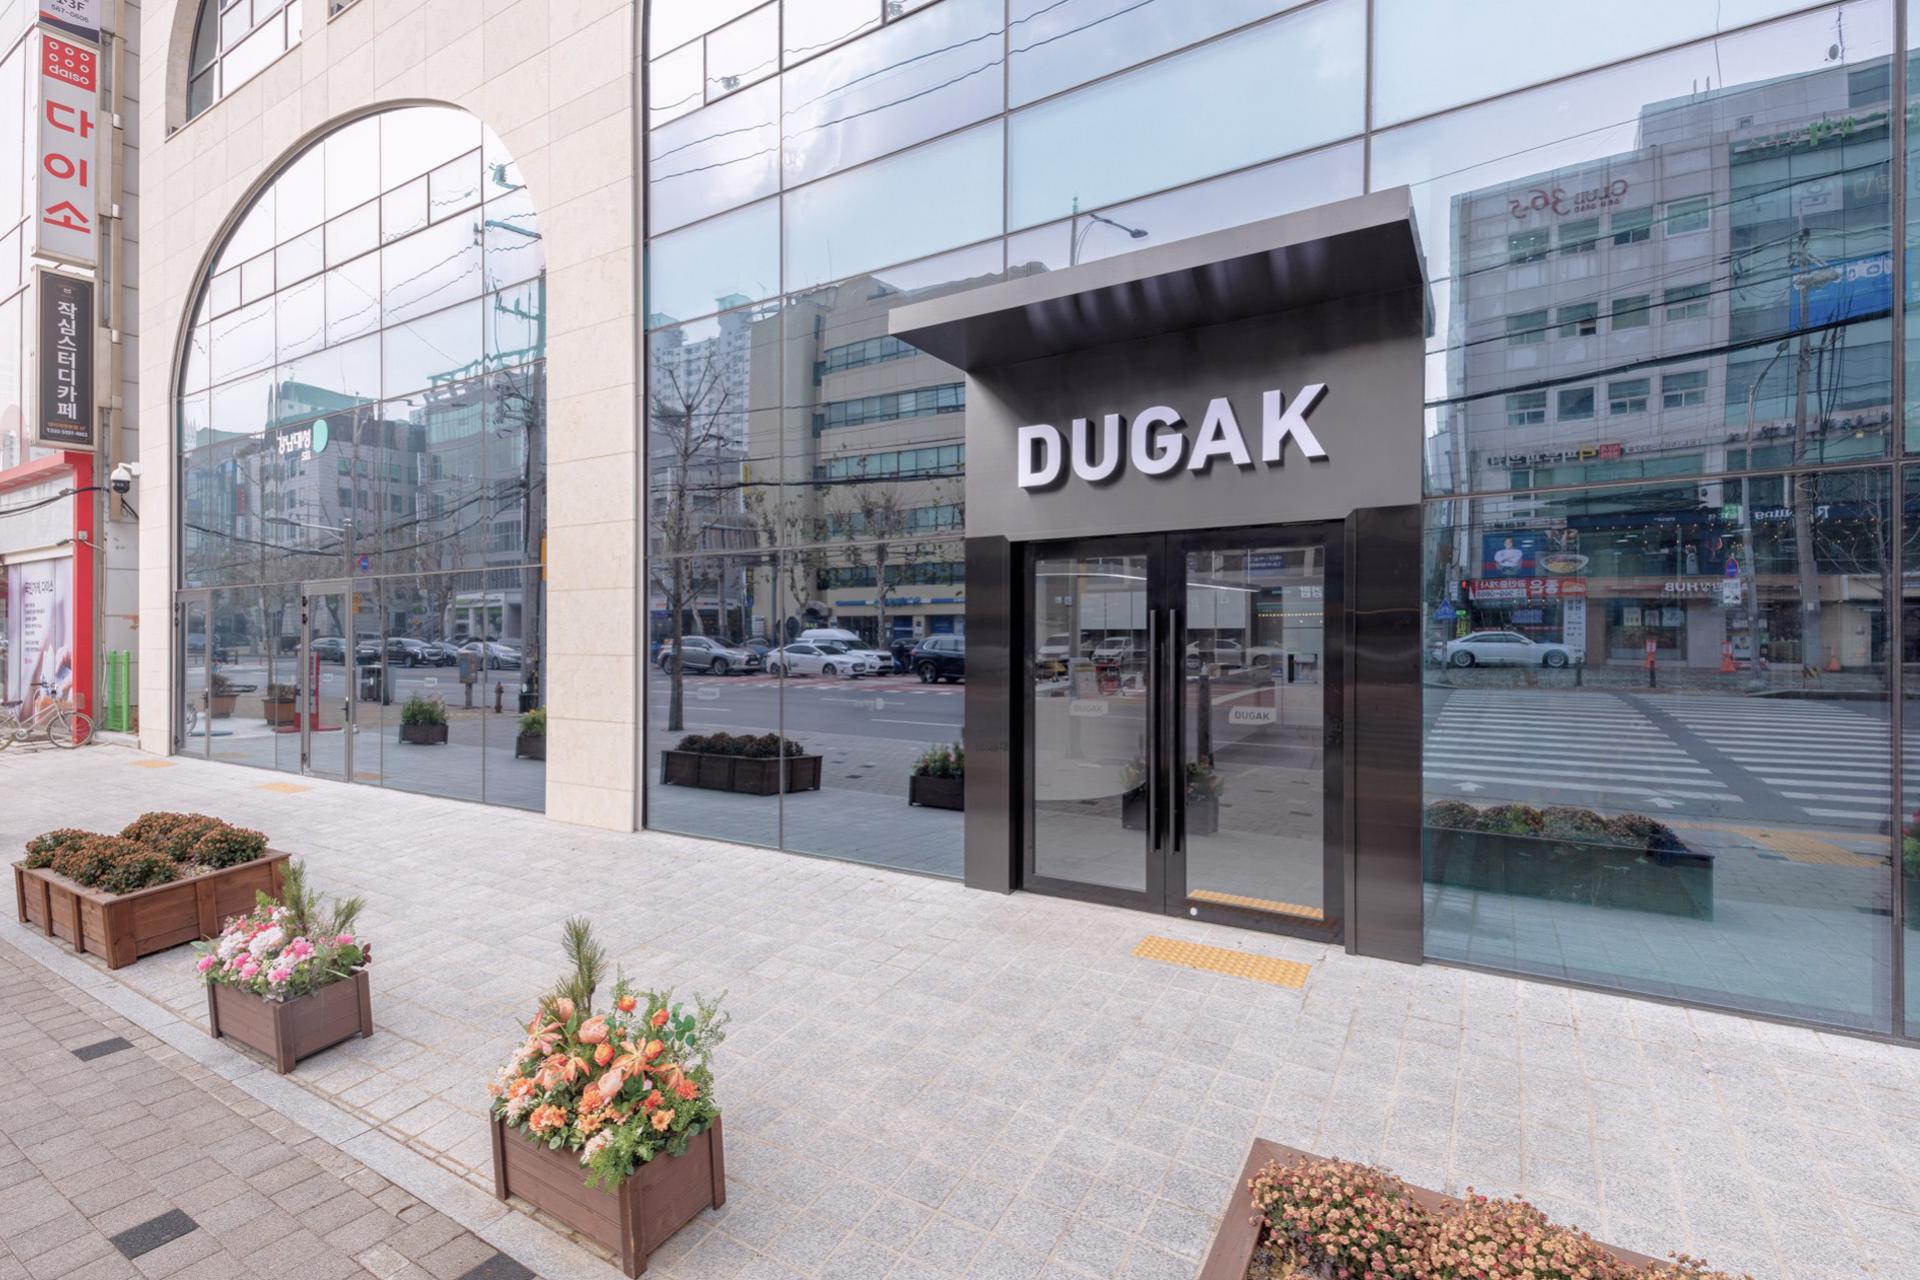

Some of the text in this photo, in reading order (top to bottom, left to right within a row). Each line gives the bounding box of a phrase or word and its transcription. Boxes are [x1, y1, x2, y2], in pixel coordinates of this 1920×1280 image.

[48, 64, 89, 85] daiso
[43, 100, 95, 235] 다이소
[56, 301, 78, 420] 작심스터디카페
[1017, 382, 1328, 491] DUGAK
[1234, 710, 1269, 720] DUGAK
